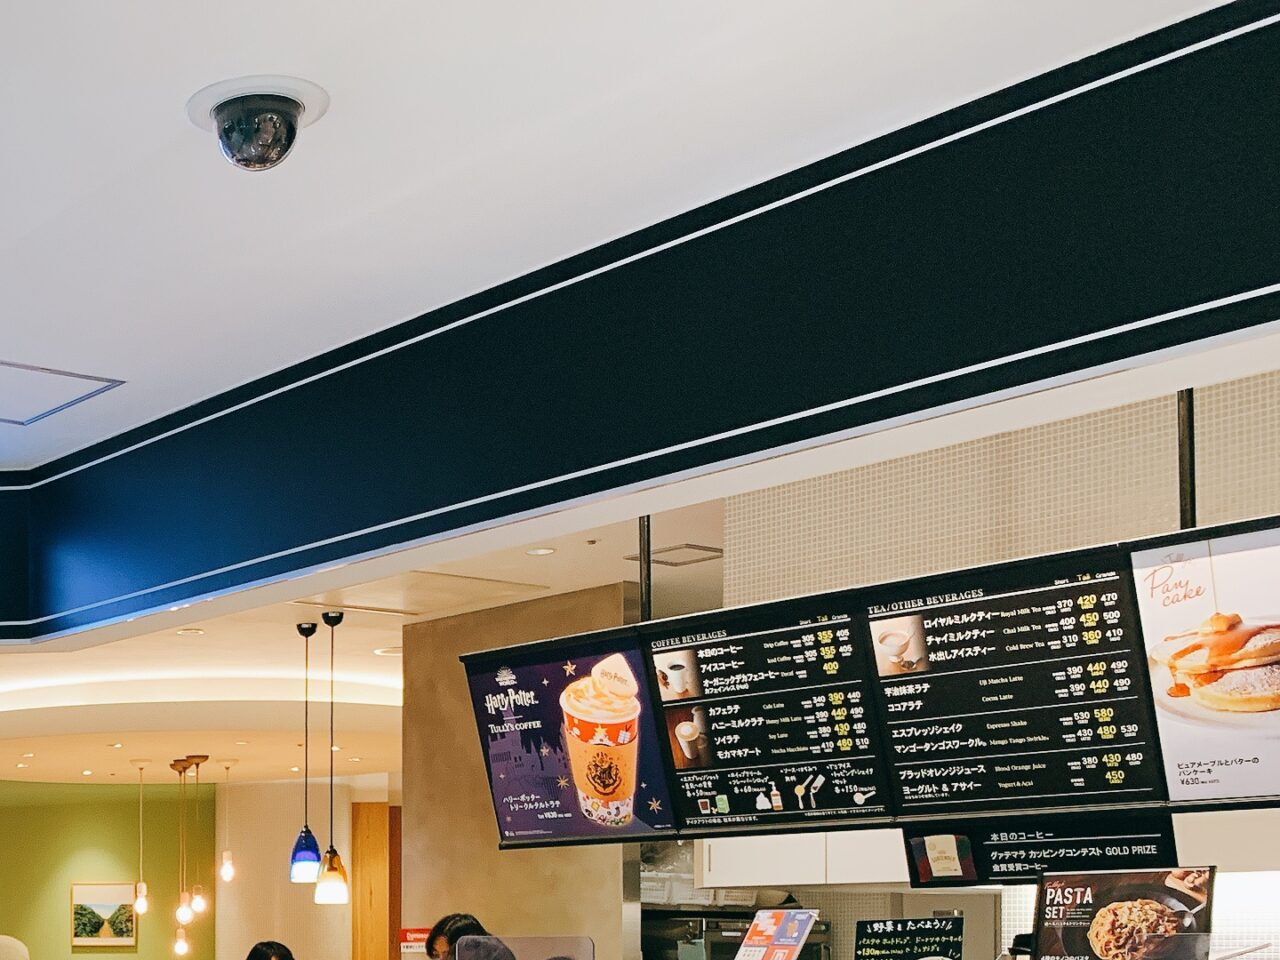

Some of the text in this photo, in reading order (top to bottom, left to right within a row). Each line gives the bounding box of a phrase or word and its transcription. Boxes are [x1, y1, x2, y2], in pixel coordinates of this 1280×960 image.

[1077, 573, 1091, 582] Tall
[1144, 565, 1189, 599] Pan
[868, 589, 984, 615] TEA/OTHER BEVERAGES
[1162, 585, 1206, 608] cake
[924, 611, 1000, 629] ロイヤルミルクティー
[1057, 599, 1074, 609] 370
[1077, 594, 1097, 606] 420
[1100, 592, 1118, 602] 470
[651, 630, 727, 649] COFFEE BEVERAGES
[926, 628, 995, 646] チャイミルクティー
[1059, 617, 1076, 626] 400
[1079, 612, 1099, 623] 450
[1103, 610, 1121, 620] 500
[697, 629, 850, 659] 本日のコーヒー 305 355 405
[928, 645, 996, 663] 水出しアイスティー
[1062, 634, 1079, 644] 310
[1082, 630, 1102, 641] 360
[1105, 628, 1124, 638] 410
[701, 661, 745, 673] アイスコーヒー
[819, 646, 836, 656] 355
[839, 644, 853, 653] 405
[703, 661, 839, 687] オーガニックデカフェコーヒー 400
[884, 683, 931, 698] 宇治抹茶ラテ
[1066, 665, 1084, 676] 390
[1087, 661, 1107, 672] 440
[1110, 660, 1128, 670] 490
[485, 689, 536, 714] Harry Potter
[709, 705, 741, 717] カフェラテ
[828, 692, 845, 702] 390
[847, 691, 861, 699] 440
[887, 700, 923, 713] ココアラテ
[1069, 683, 1086, 693] 390
[1089, 679, 1109, 690] 440
[1113, 677, 1131, 687] 490
[488, 720, 542, 734] TULLY'S COFFEE
[712, 716, 765, 730] ハニーミルクラテ
[831, 708, 847, 717] 440
[892, 722, 963, 739] エスプレッソシェイク
[1073, 711, 1091, 721] 530
[1094, 707, 1114, 718] 580
[1076, 728, 1093, 738] 430
[1096, 725, 1117, 736] 480
[1120, 723, 1139, 734] 530
[714, 734, 741, 746] ソイラテ
[834, 723, 850, 732] 430
[717, 747, 762, 759] モカマキアート
[821, 741, 835, 749] 410
[855, 737, 870, 746] 510
[899, 764, 987, 780] ブラッドオレンジジュース
[1082, 756, 1099, 766] 380
[1101, 753, 1122, 764] 430
[1125, 752, 1143, 762] 480
[1177, 757, 1260, 770] ピュアメープルとバターの
[1178, 768, 1213, 777] パンケーキ
[902, 770, 1125, 794] ヨーグルト & アサイー 450
[1180, 777, 1200, 786] ¥630
[990, 831, 1054, 842] 本日のコーヒー
[990, 844, 1158, 861] グァテマラ カッピングコンテスト GOLD PRIZE
[992, 862, 1049, 872] 金賞受賞コーヒー
[1046, 887, 1093, 905] PASTA
[1045, 906, 1065, 919] SET
